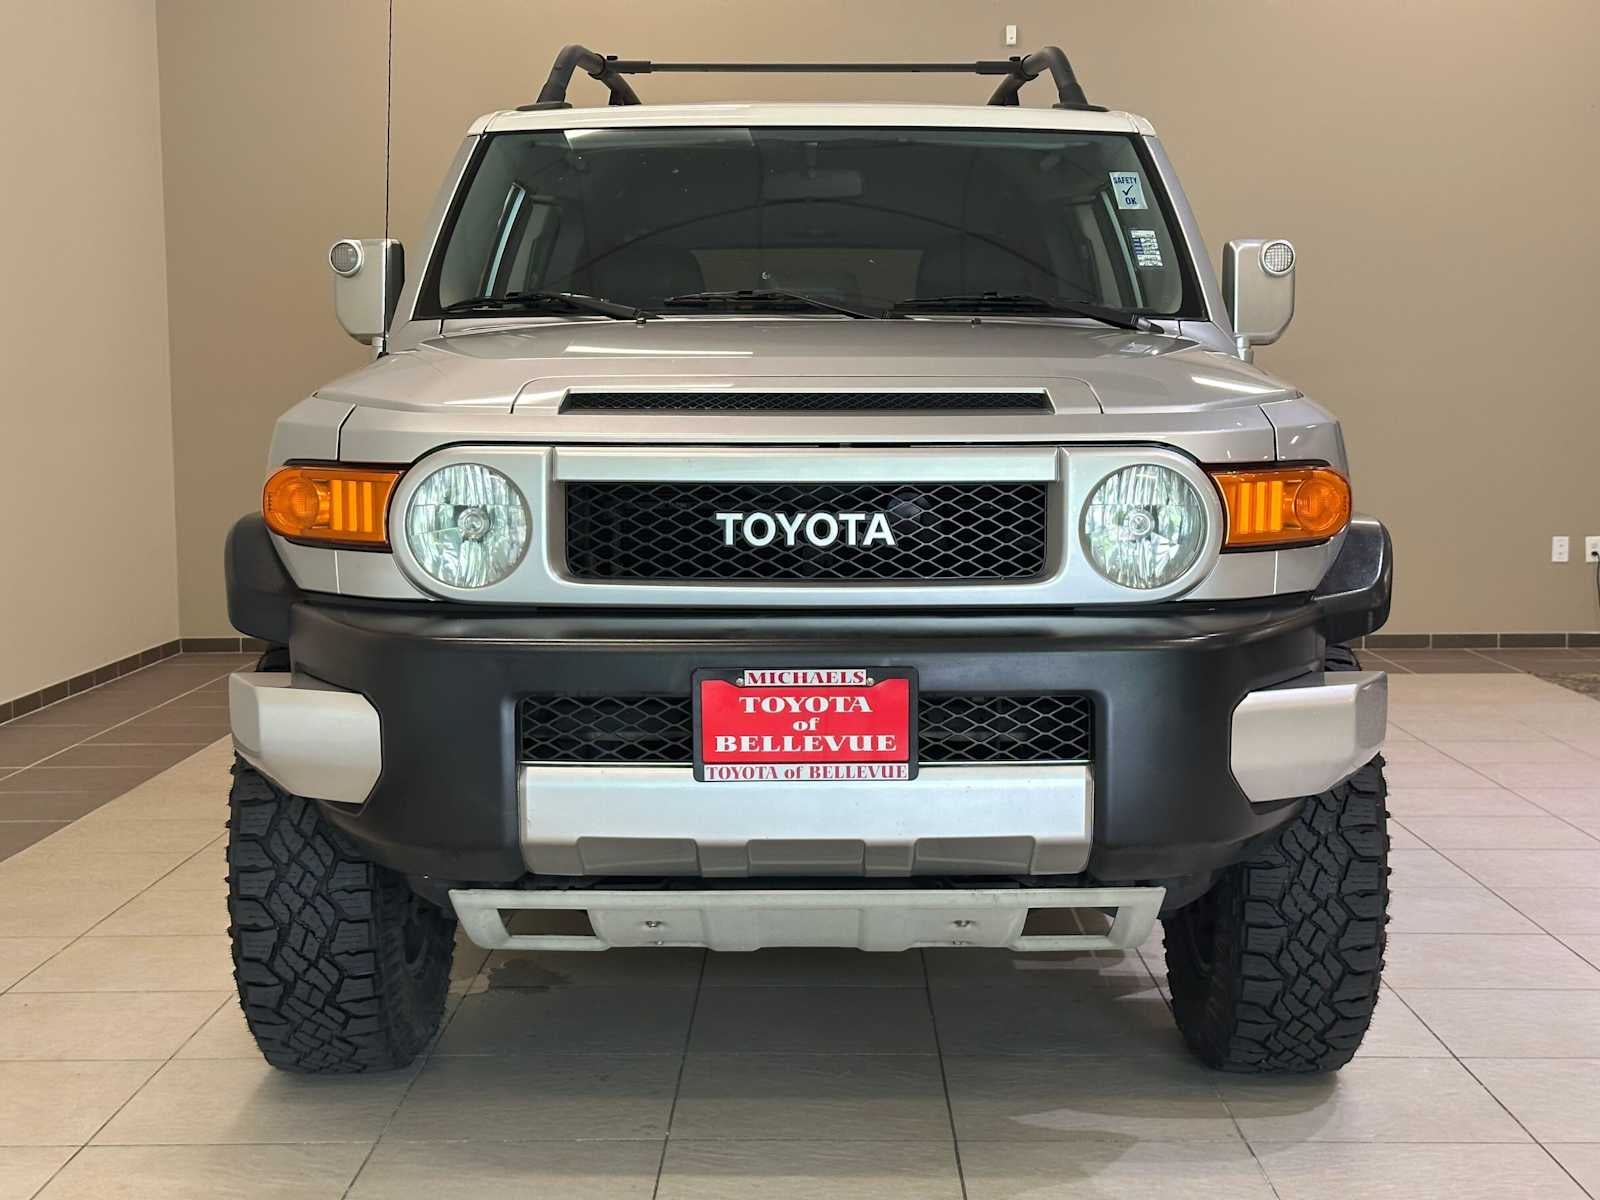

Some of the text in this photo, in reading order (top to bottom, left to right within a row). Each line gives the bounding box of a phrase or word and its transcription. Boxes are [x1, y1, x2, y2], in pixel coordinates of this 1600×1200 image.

[1113, 176, 1137, 184] SAFETY
[1125, 197, 1137, 205] OK
[715, 512, 896, 547] TOYOTA
[748, 671, 865, 685] MICHAELS
[738, 696, 873, 713] TOYOTA
[792, 717, 820, 731] of
[714, 735, 897, 752] BELLEVUE
[706, 765, 907, 779] TOYOTA of BELLEVUE
